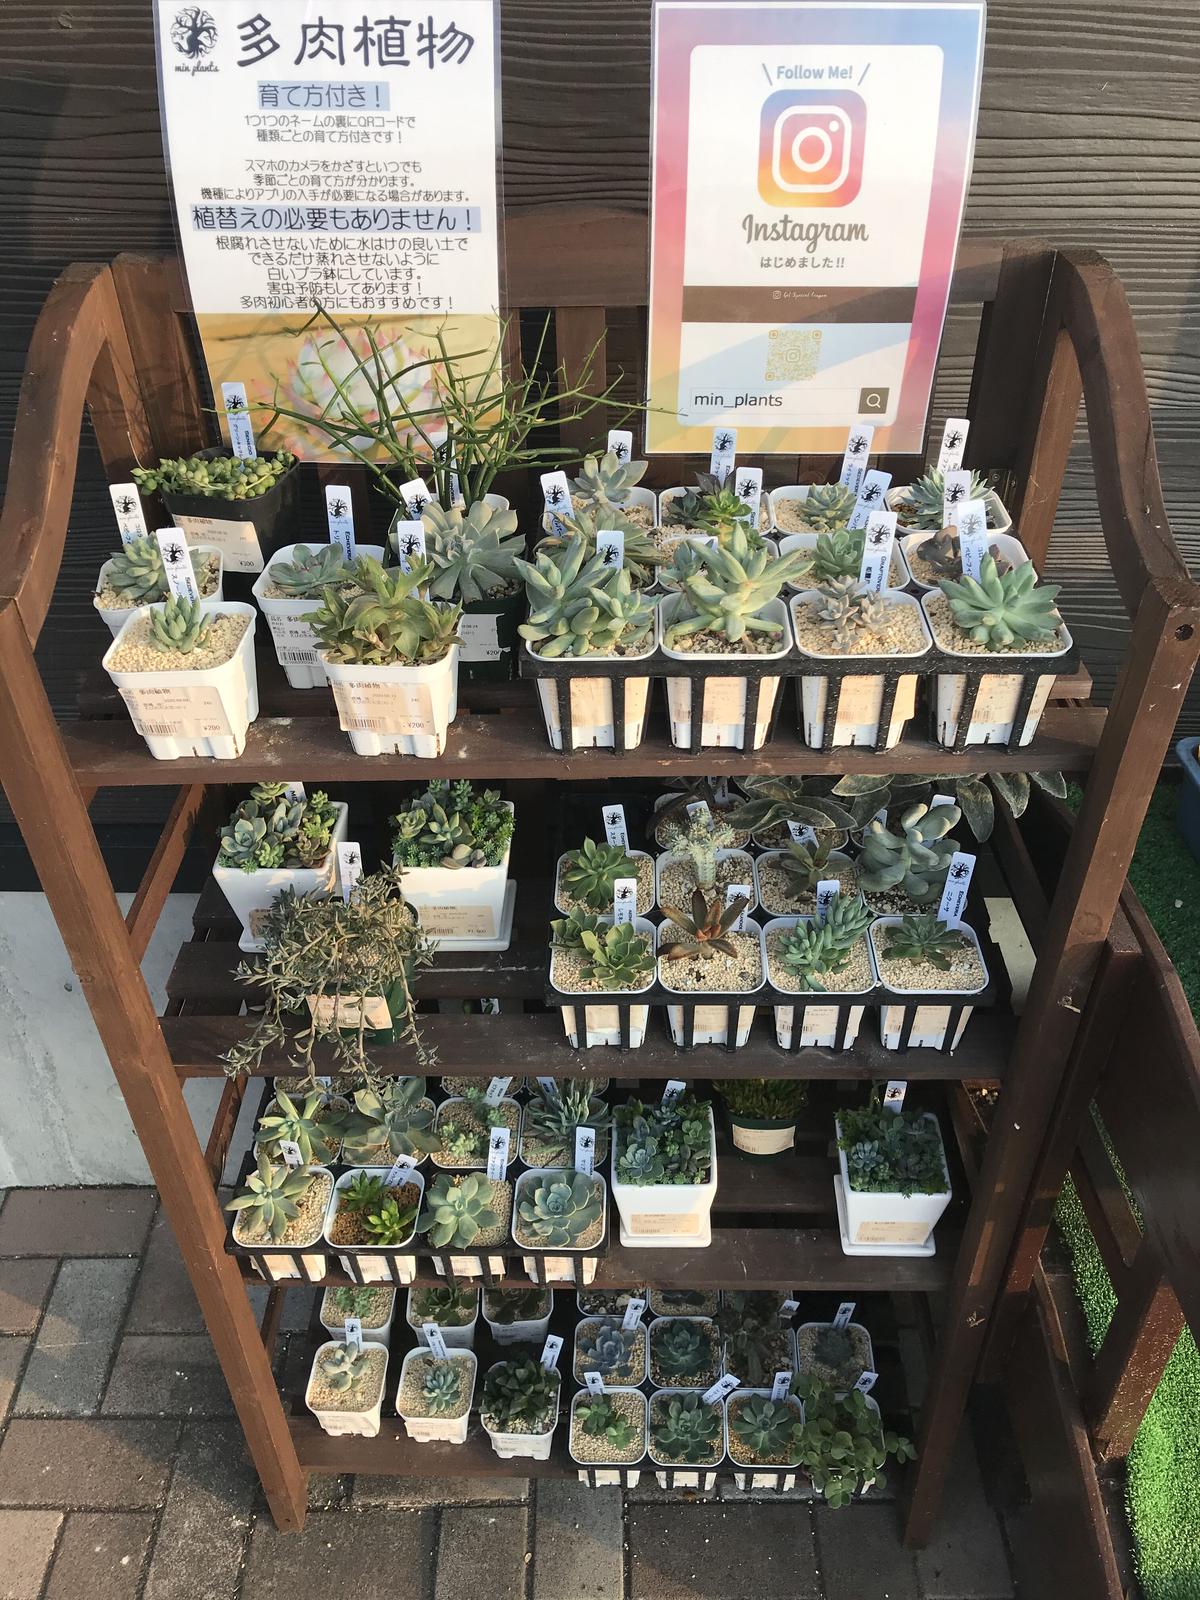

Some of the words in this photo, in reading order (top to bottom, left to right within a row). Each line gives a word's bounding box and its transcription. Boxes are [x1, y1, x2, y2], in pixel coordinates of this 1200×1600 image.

[236, 13, 475, 69] 多肉植物
[175, 63, 190, 72] min
[191, 60, 219, 76] plants
[776, 65, 824, 80] Follow
[828, 65, 853, 80] Me!
[245, 159, 422, 173] スマホのカメラをかざすといつでも
[253, 174, 415, 187] 季節ごとの育て方が分かります。
[742, 214, 869, 253] Instagram
[215, 236, 468, 251] 根腐れさせないために水はけの良い土で
[251, 252, 440, 265] できるだけ蒸れさせないように
[694, 392, 783, 408] min_plants
[244, 430, 252, 455] SENECIO
[875, 555, 886, 593] GRAPTOVER
[952, 890, 964, 917] ECHEVERIA
